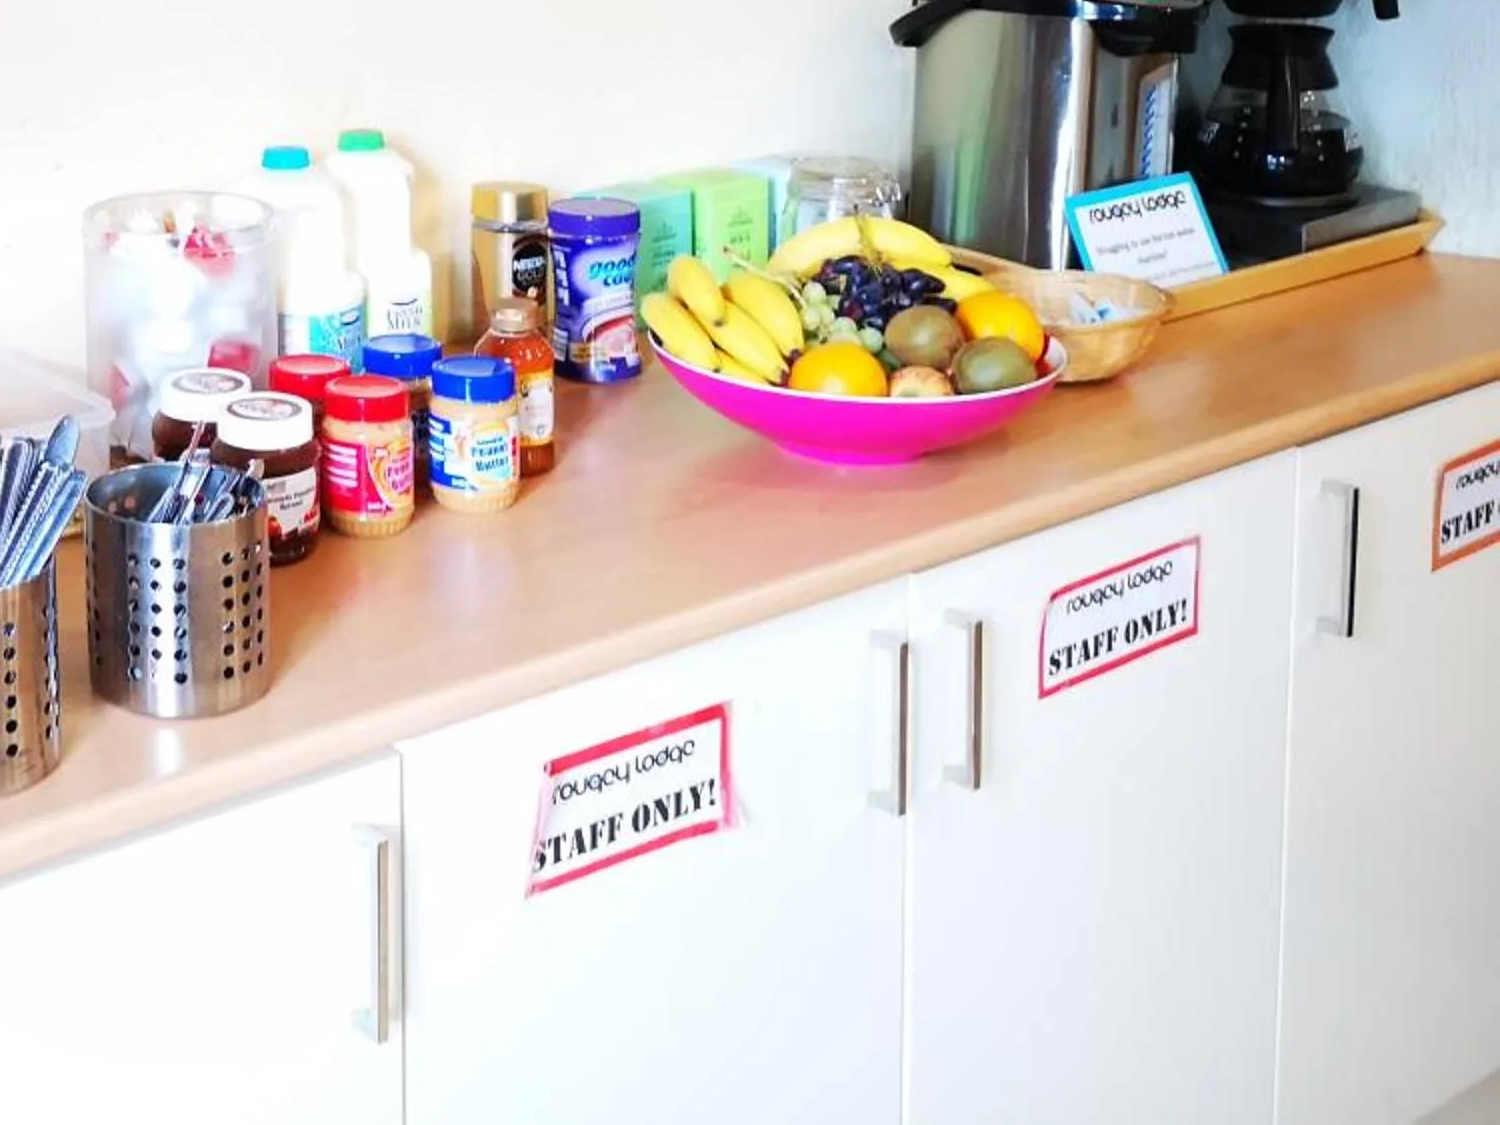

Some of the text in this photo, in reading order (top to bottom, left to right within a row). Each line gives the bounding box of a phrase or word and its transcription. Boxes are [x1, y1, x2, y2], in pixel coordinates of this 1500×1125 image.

[1441, 500, 1495, 544] STAFF
[1049, 599, 1188, 676] STAFF ONLY!
[532, 778, 717, 874] STAFF ONLY!
